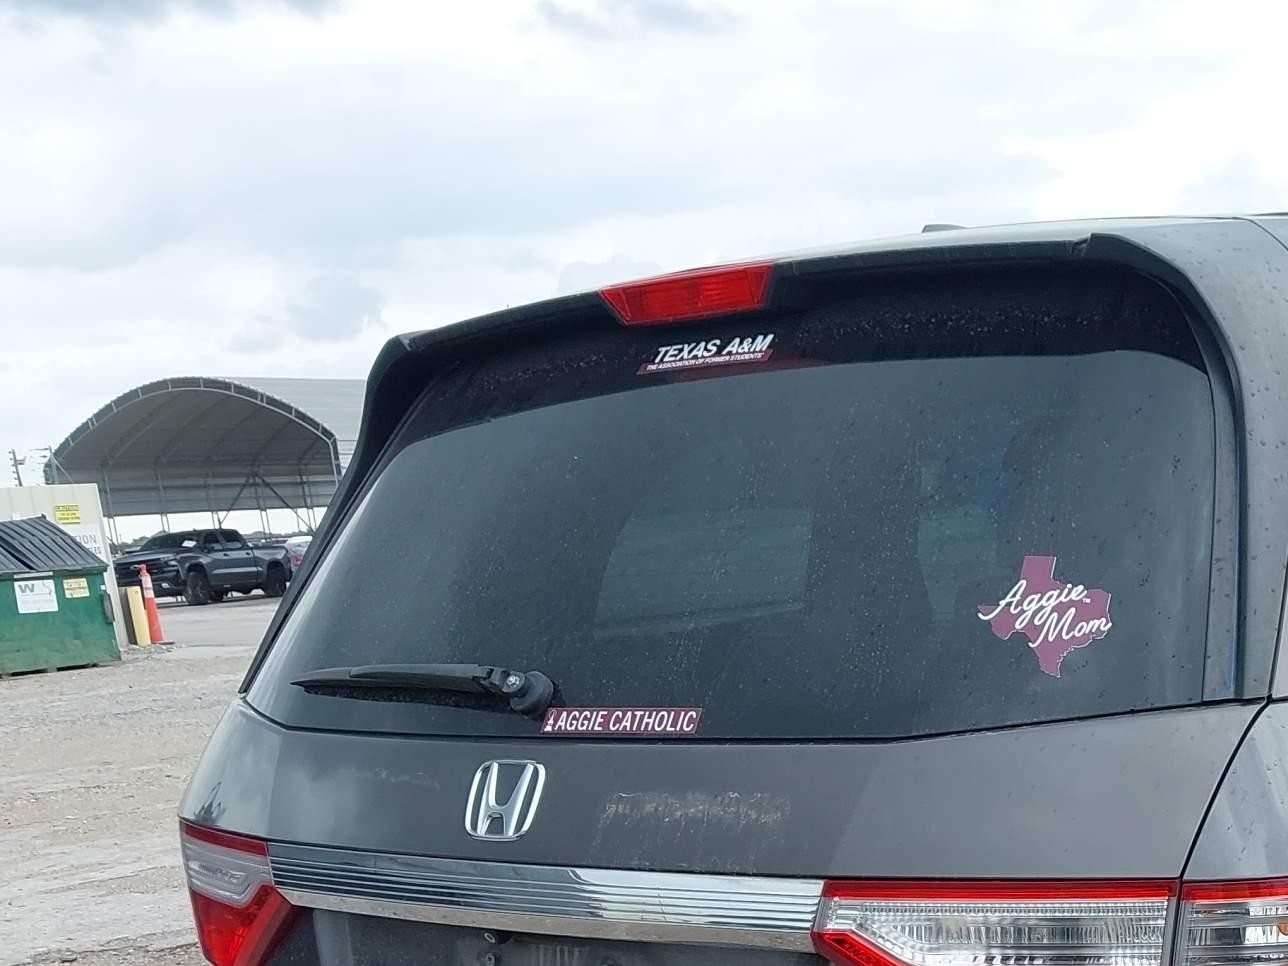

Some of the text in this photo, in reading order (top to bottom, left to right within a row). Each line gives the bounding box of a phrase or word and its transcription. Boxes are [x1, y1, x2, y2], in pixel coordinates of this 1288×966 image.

[646, 363, 658, 371] THE
[658, 360, 696, 370] ASSOCIATION
[704, 356, 731, 364] FORMER
[730, 352, 765, 361] STUDENTS
[654, 334, 774, 363] TEXAS A&M
[977, 579, 1088, 629] Aggie
[1028, 607, 1113, 648] Mom
[554, 710, 697, 732] AGGIE CATHOLIC
